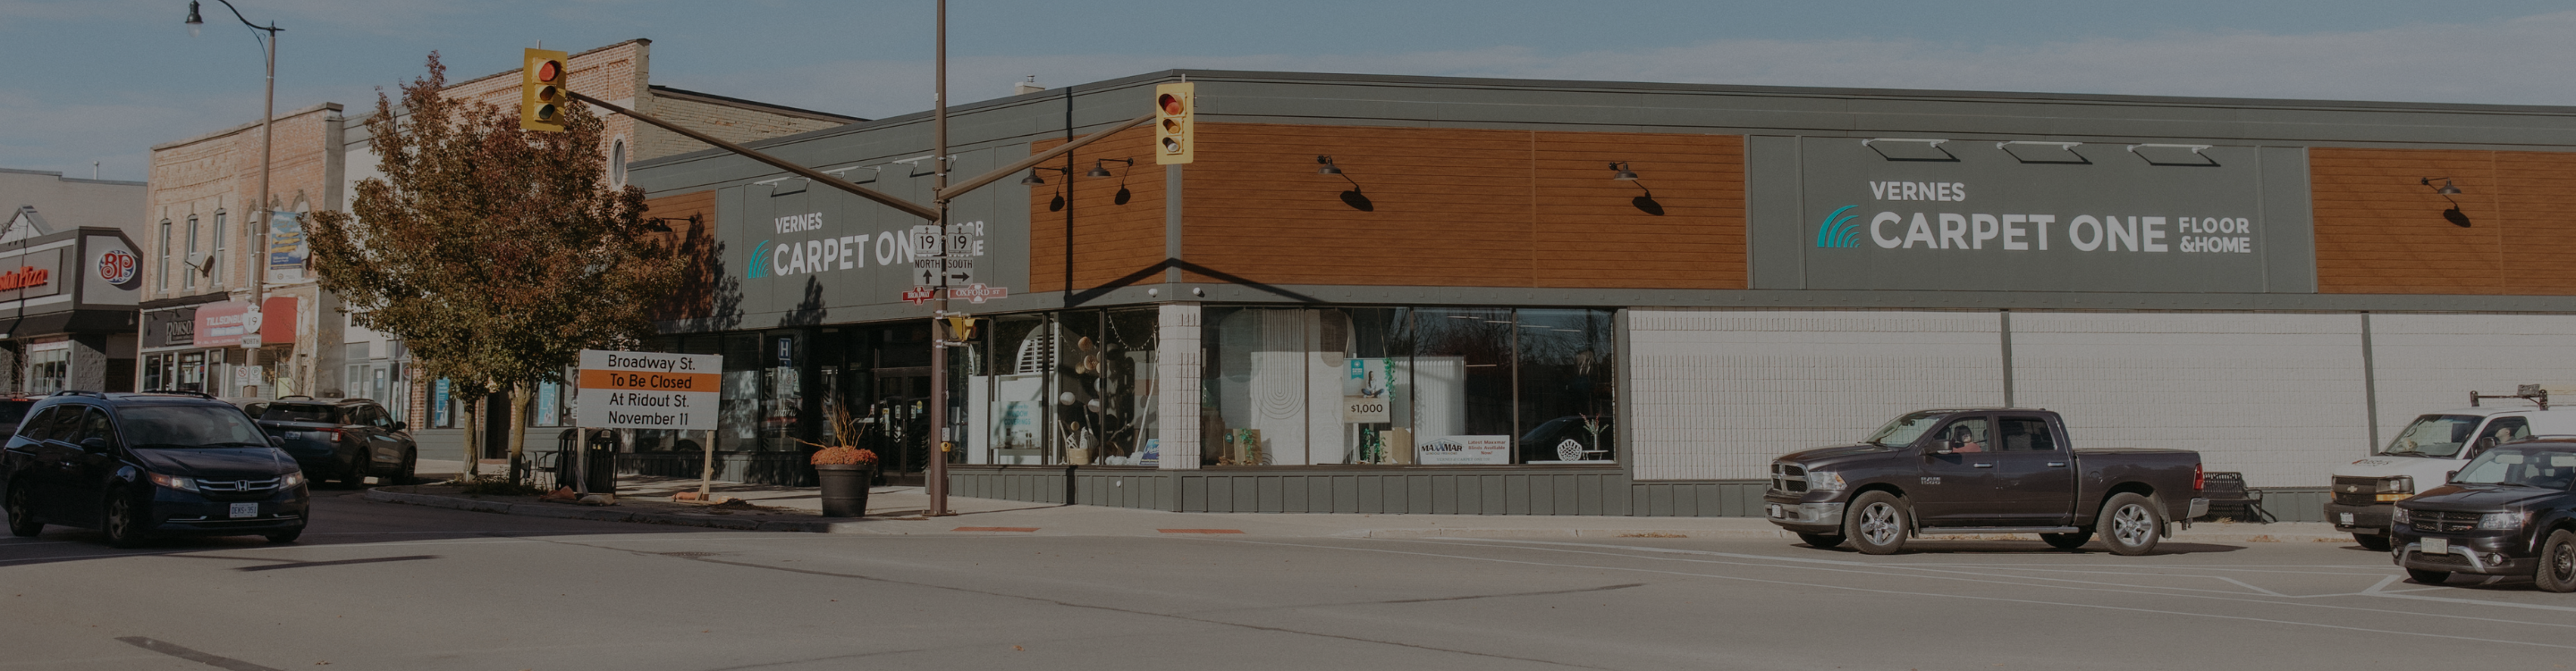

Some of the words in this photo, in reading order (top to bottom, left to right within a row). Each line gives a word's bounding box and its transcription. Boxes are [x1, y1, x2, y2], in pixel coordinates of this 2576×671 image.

[1870, 180, 1966, 202] VERNES
[774, 212, 823, 234] VERNES
[2178, 216, 2250, 235] FLOOR
[1870, 211, 2056, 251] CARPET
[2068, 214, 2168, 253] ONE
[920, 235, 934, 249] 19
[953, 235, 967, 249] 19
[2179, 236, 2251, 254] &HOME
[773, 234, 869, 277] CARPET
[875, 229, 915, 266] ON
[100, 253, 133, 280] BP
[915, 259, 941, 268] NORTH
[948, 259, 973, 268] SOUTH
[0, 271, 19, 291] ston
[18, 266, 47, 288] Pizza
[908, 290, 930, 298] BROADWAY
[955, 289, 990, 297] OXFORD
[206, 315, 243, 326] TILLSONBU
[248, 316, 258, 326] 19
[242, 337, 259, 345] NORTH
[608, 354, 676, 373] Broadway
[680, 356, 696, 371] St.
[610, 373, 624, 387] To
[629, 374, 646, 388] Be
[650, 374, 692, 389] Closed
[609, 392, 624, 406] At
[628, 393, 671, 407] Ridout
[673, 394, 689, 407] St.
[1350, 404, 1383, 414] $1,000
[608, 411, 675, 425] November
[680, 413, 688, 425] 11
[1421, 440, 1463, 452] MAXXMAR
